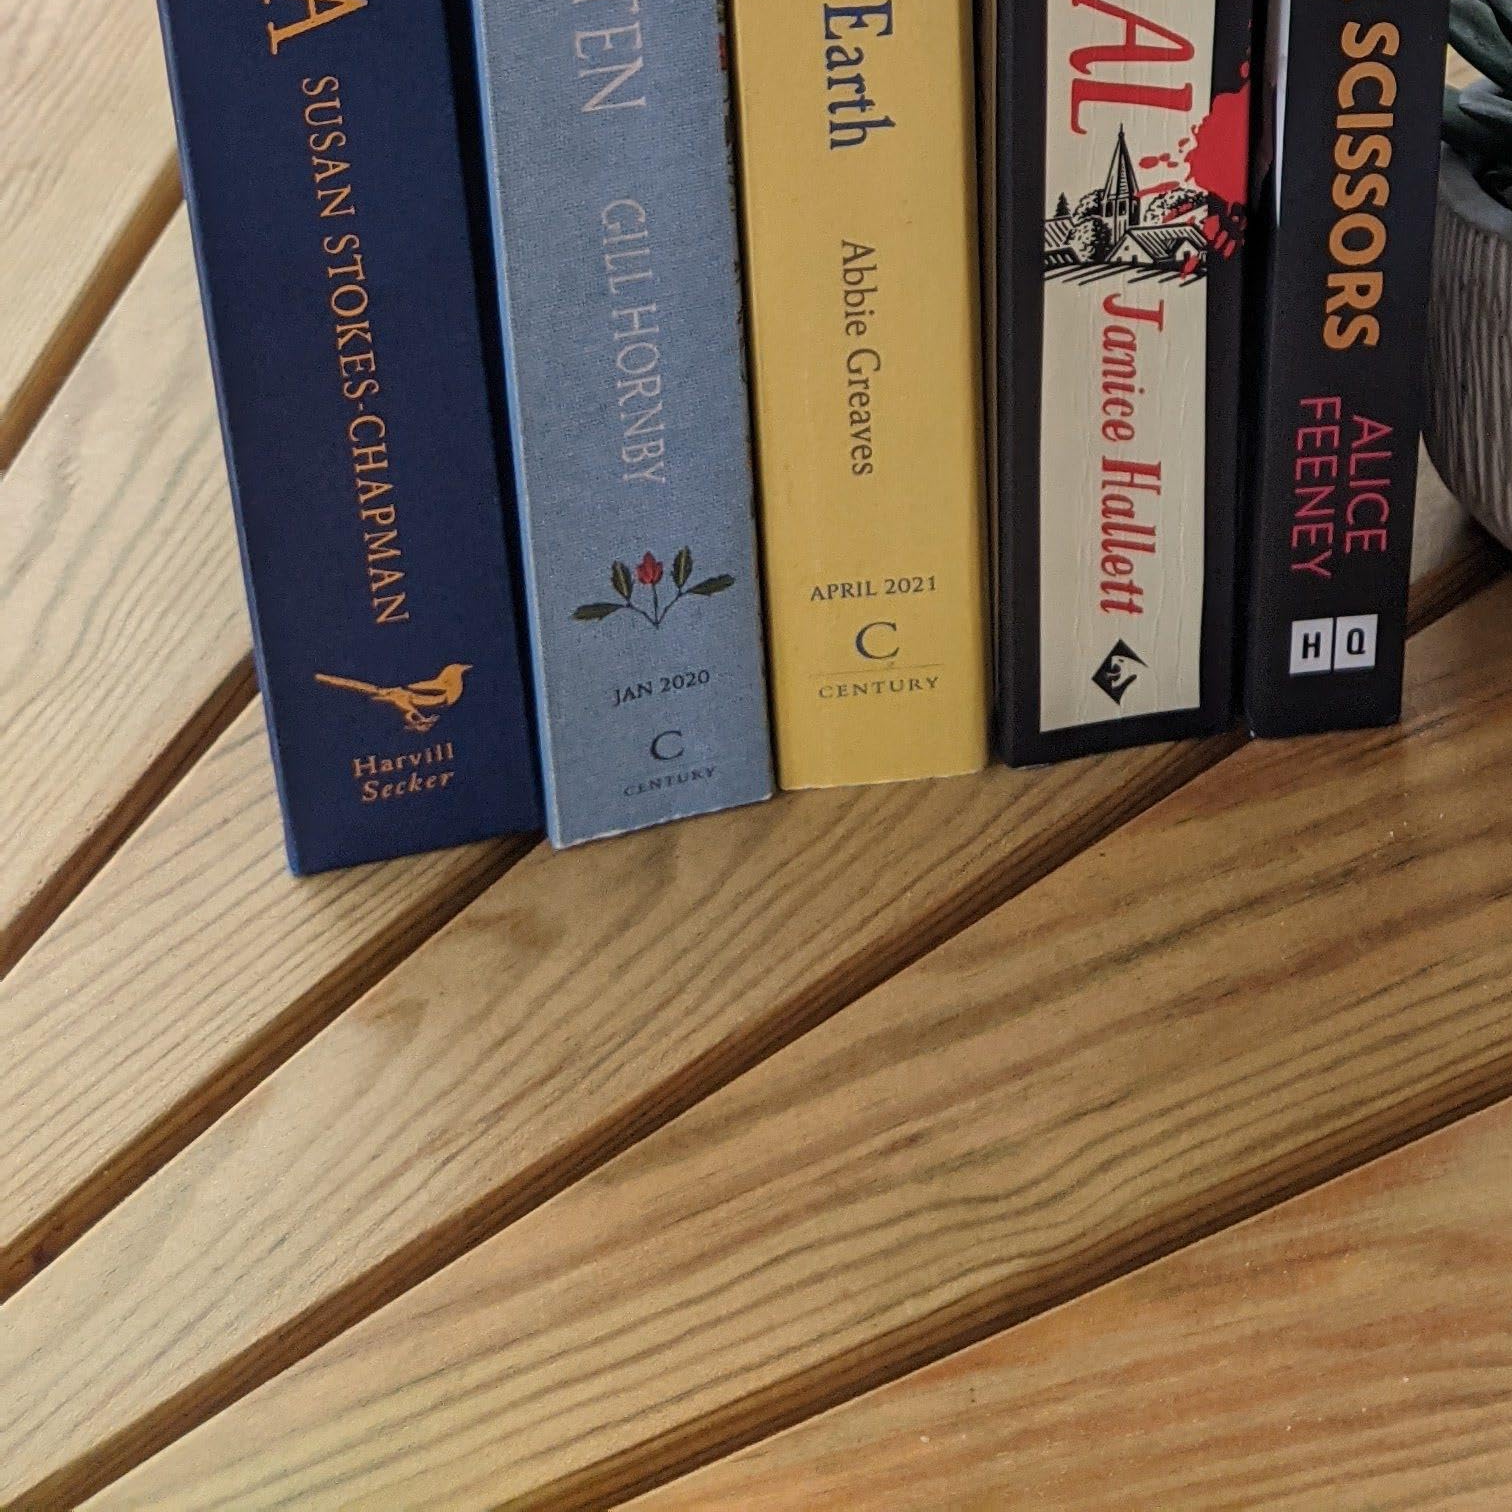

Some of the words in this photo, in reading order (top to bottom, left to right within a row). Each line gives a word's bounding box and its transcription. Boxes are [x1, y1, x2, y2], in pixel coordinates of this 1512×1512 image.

[301, 76, 356, 219] SUSAN
[1322, 20, 1400, 352] SCISSORS
[600, 199, 653, 296] GILL
[839, 238, 880, 336] Abbie
[322, 233, 409, 625] STOKES-CHAPMAN
[611, 305, 667, 485] HORNBY
[841, 346, 881, 477] Greaves
[1100, 291, 1166, 443] Janice
[1100, 454, 1163, 616] Hallett
[1291, 396, 1341, 578] FEENEY
[1344, 414, 1392, 555] ALICE
[810, 578, 878, 603] APRIL
[884, 575, 938, 596] 2021
[612, 679, 654, 706] JAN
[660, 668, 711, 695] 2020
[817, 674, 941, 701] CENTURY
[353, 742, 456, 779] Harvill
[360, 767, 456, 804] Secker
[623, 765, 717, 797] CENTURY
